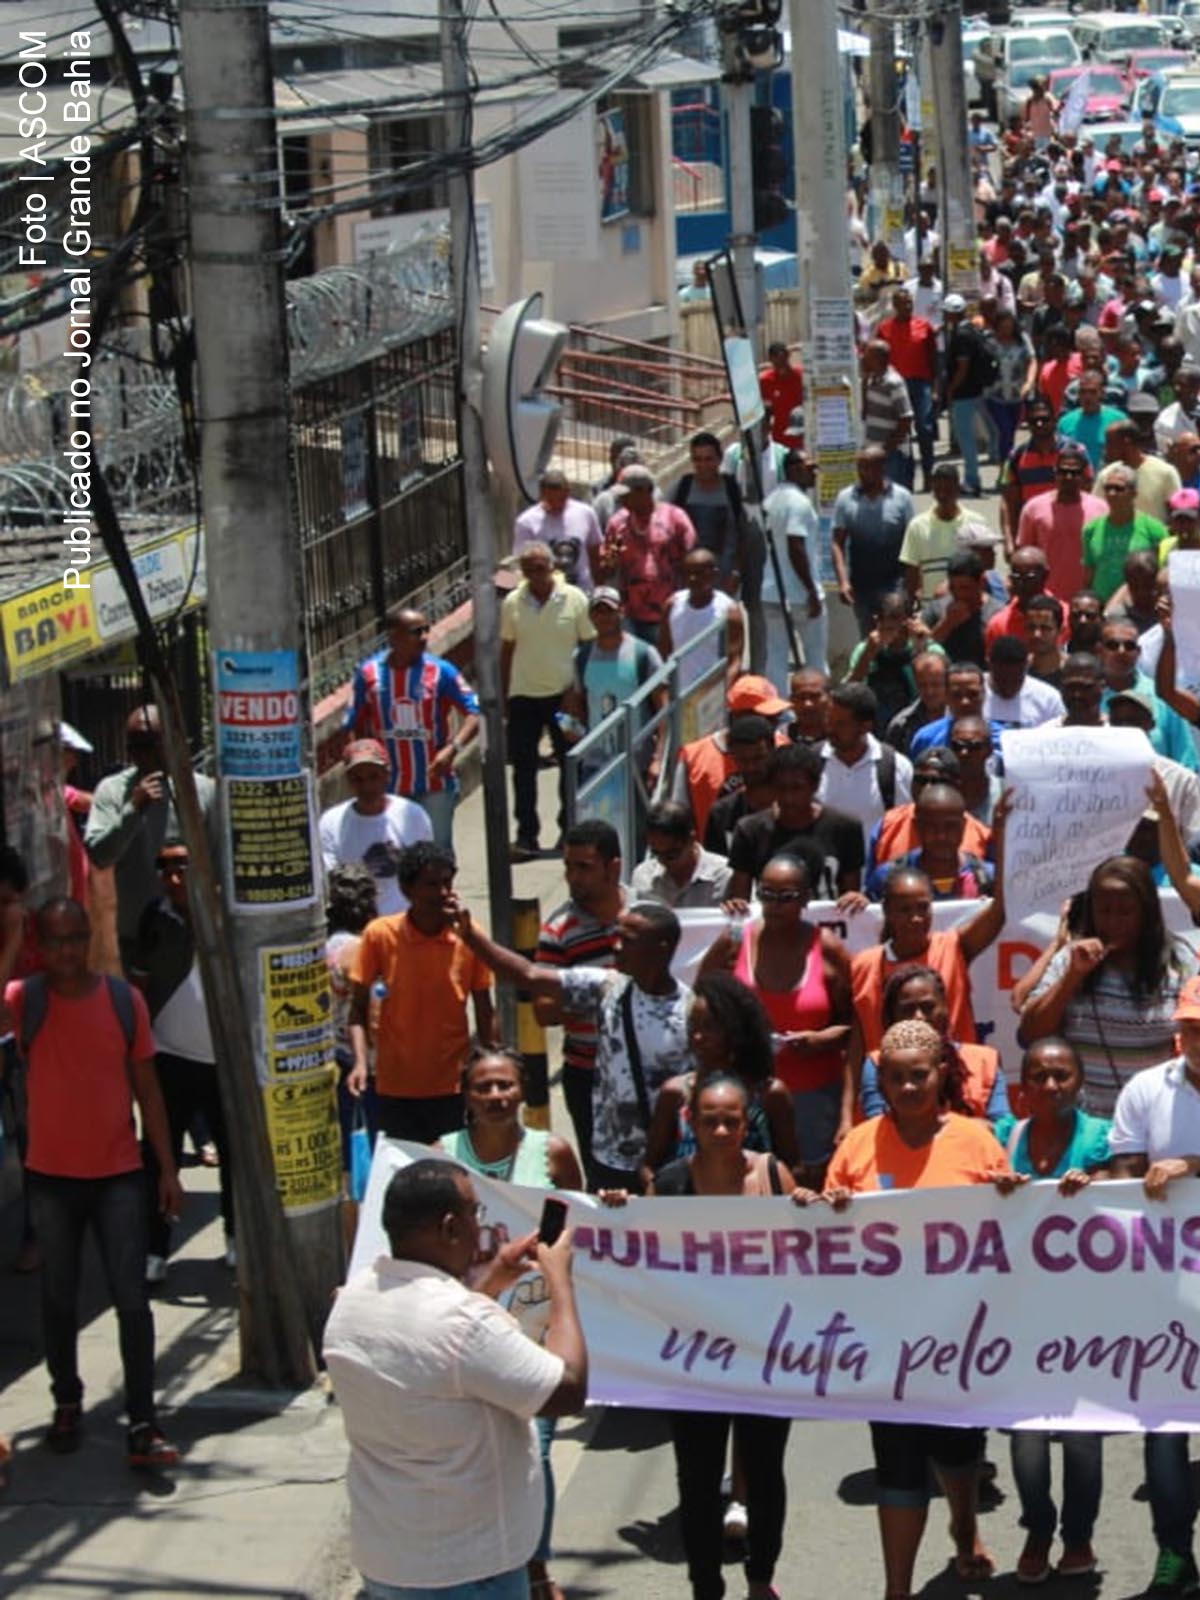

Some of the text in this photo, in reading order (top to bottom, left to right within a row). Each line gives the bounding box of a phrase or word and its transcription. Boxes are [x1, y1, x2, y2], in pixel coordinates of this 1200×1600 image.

[14, 603, 91, 657] BAVI
[220, 692, 298, 721] VENDO
[925, 1222, 1011, 1273] DA
[660, 1326, 736, 1363] na
[762, 1303, 869, 1397] luta
[893, 1300, 1011, 1400] pelo
